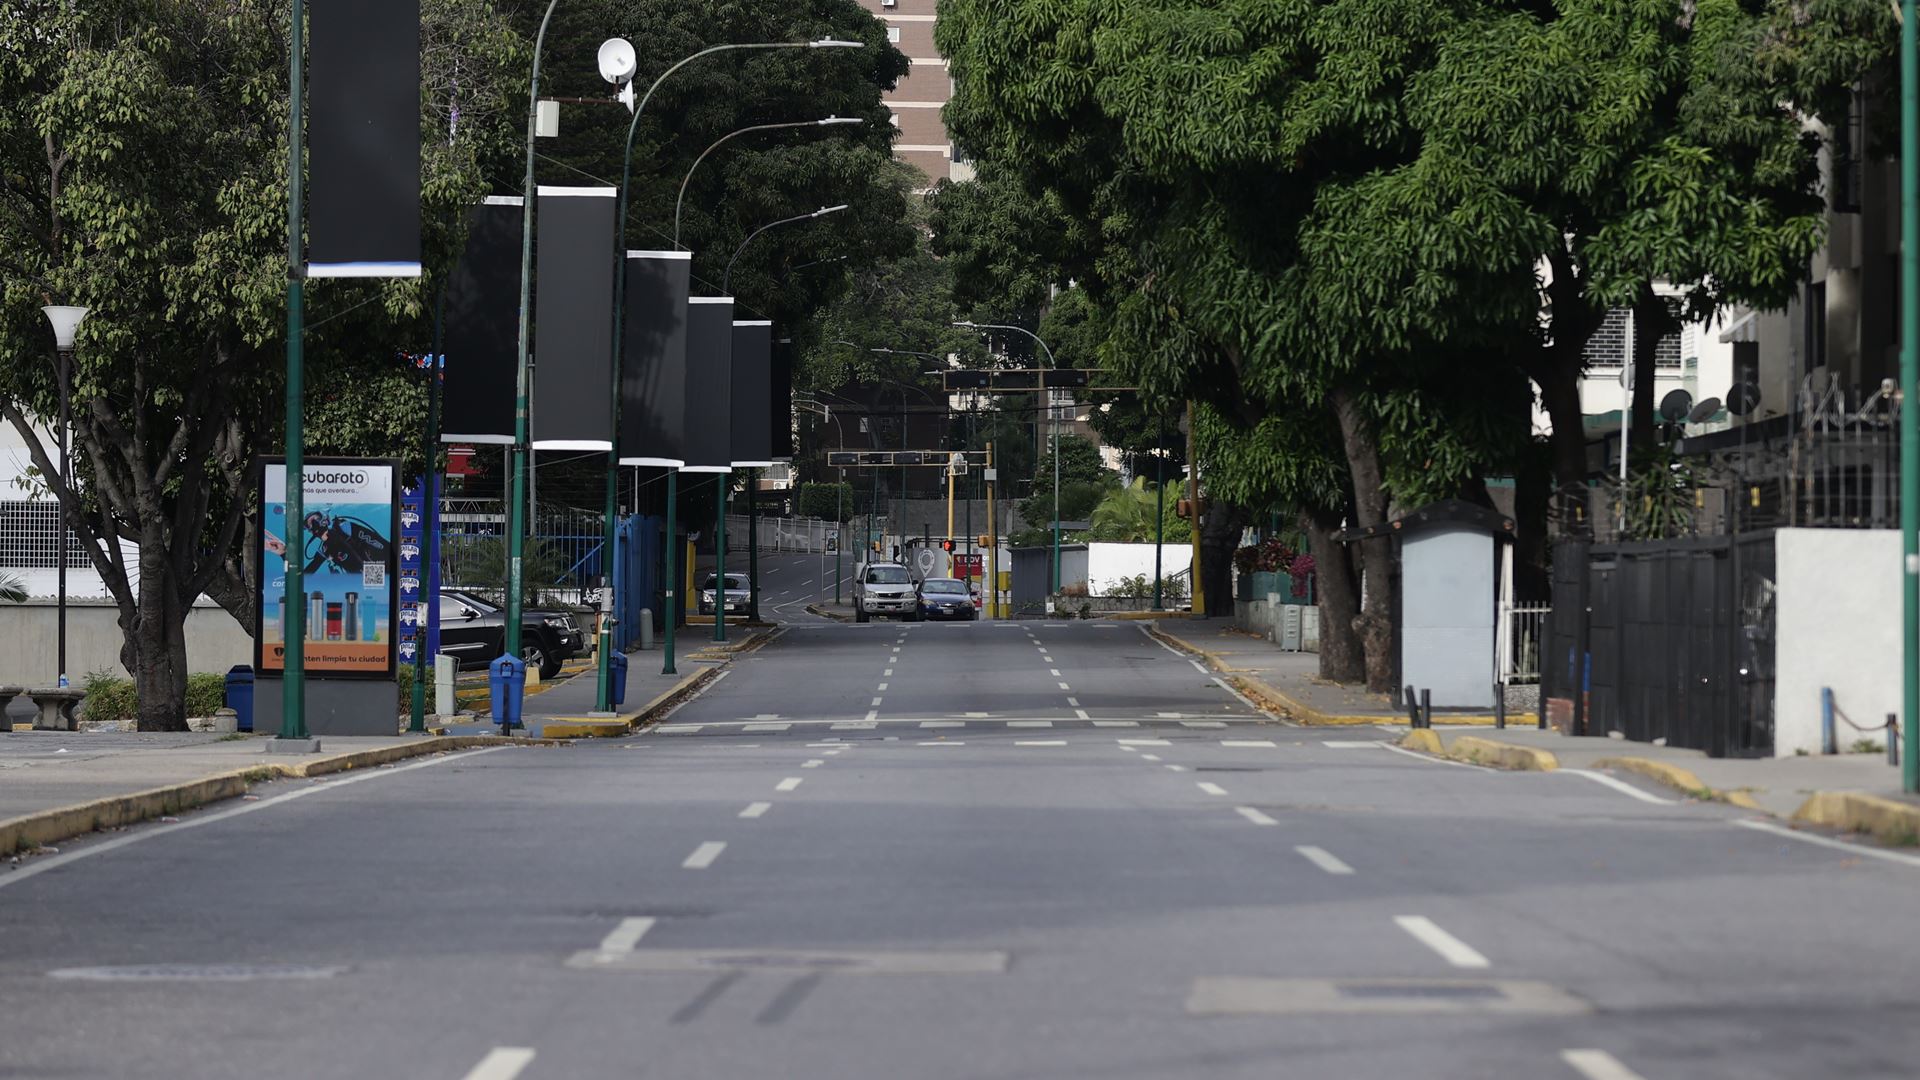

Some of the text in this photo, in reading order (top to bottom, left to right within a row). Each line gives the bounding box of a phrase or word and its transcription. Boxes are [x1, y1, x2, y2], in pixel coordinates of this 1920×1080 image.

[302, 470, 364, 484] cubafoto
[322, 655, 347, 663] limpia
[358, 655, 386, 663] ciudad
